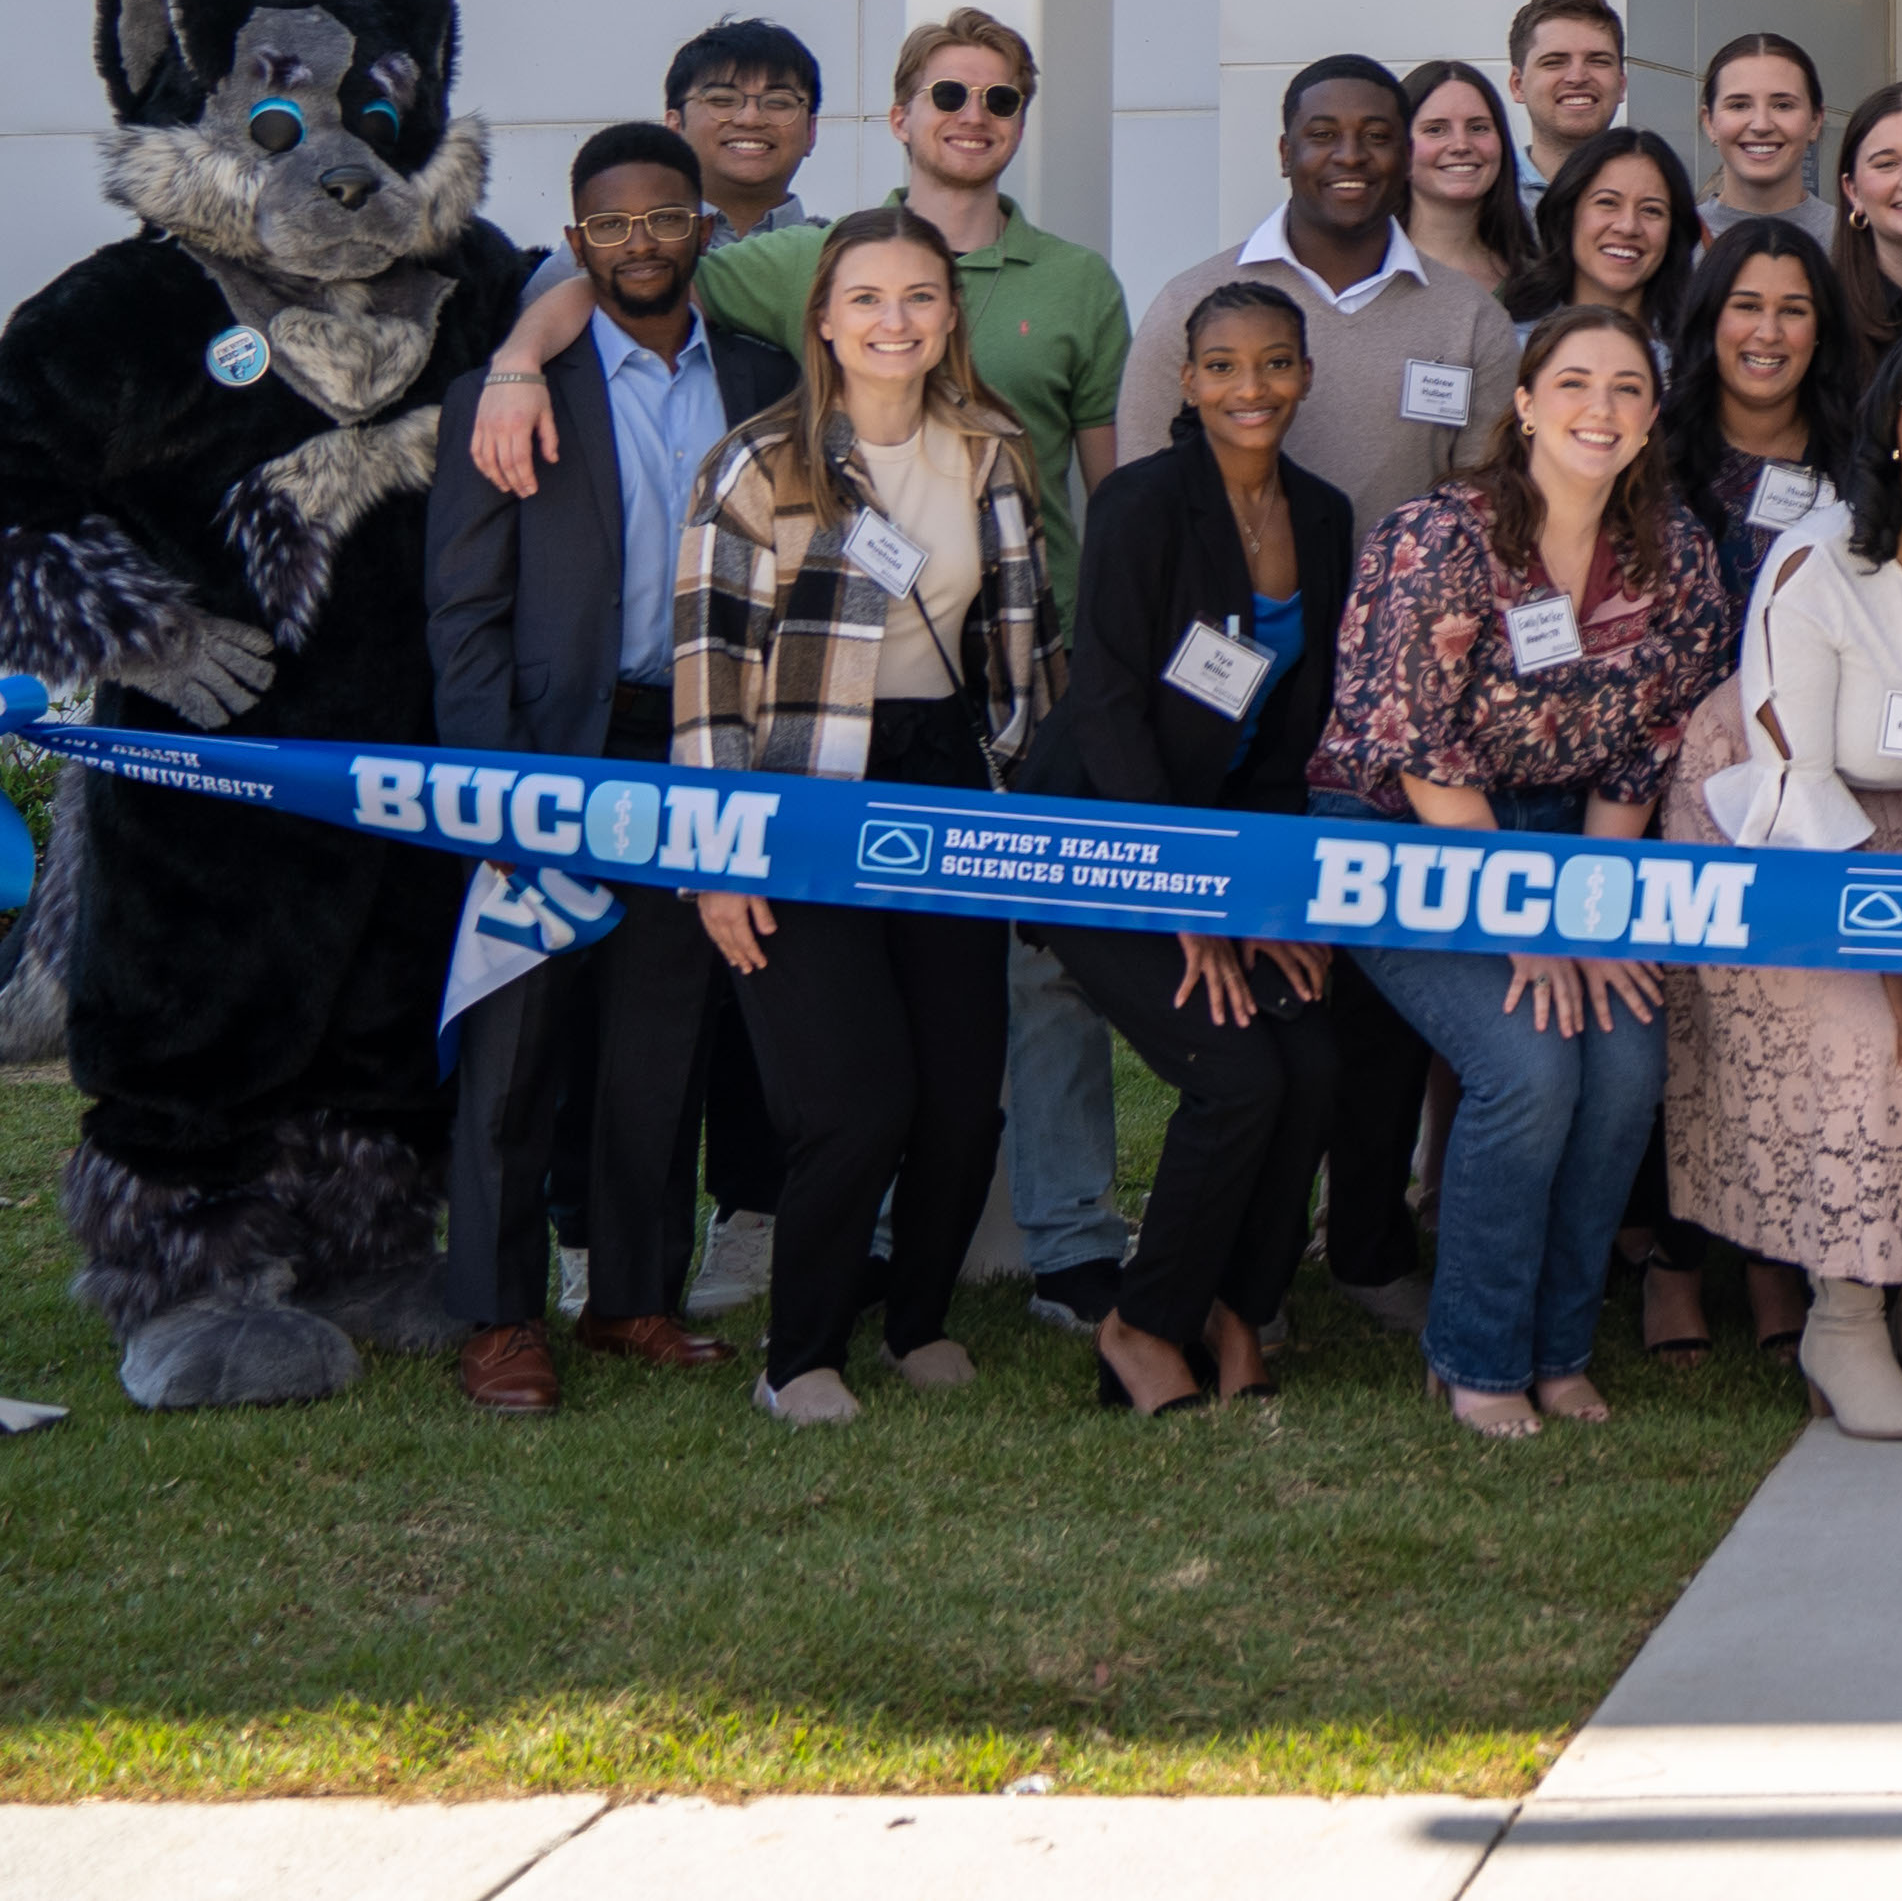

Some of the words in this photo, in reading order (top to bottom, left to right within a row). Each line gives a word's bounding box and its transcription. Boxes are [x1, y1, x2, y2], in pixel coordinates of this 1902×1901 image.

[123, 763, 274, 799] UNIVERSITY
[349, 755, 781, 878] BUCOM
[944, 828, 1051, 856] BAPTIST
[1059, 837, 1160, 864] HEALTH
[940, 855, 1064, 884] SCIENCES
[1072, 866, 1231, 896] UNIVERSITY
[1306, 838, 1757, 948] BUCOM
